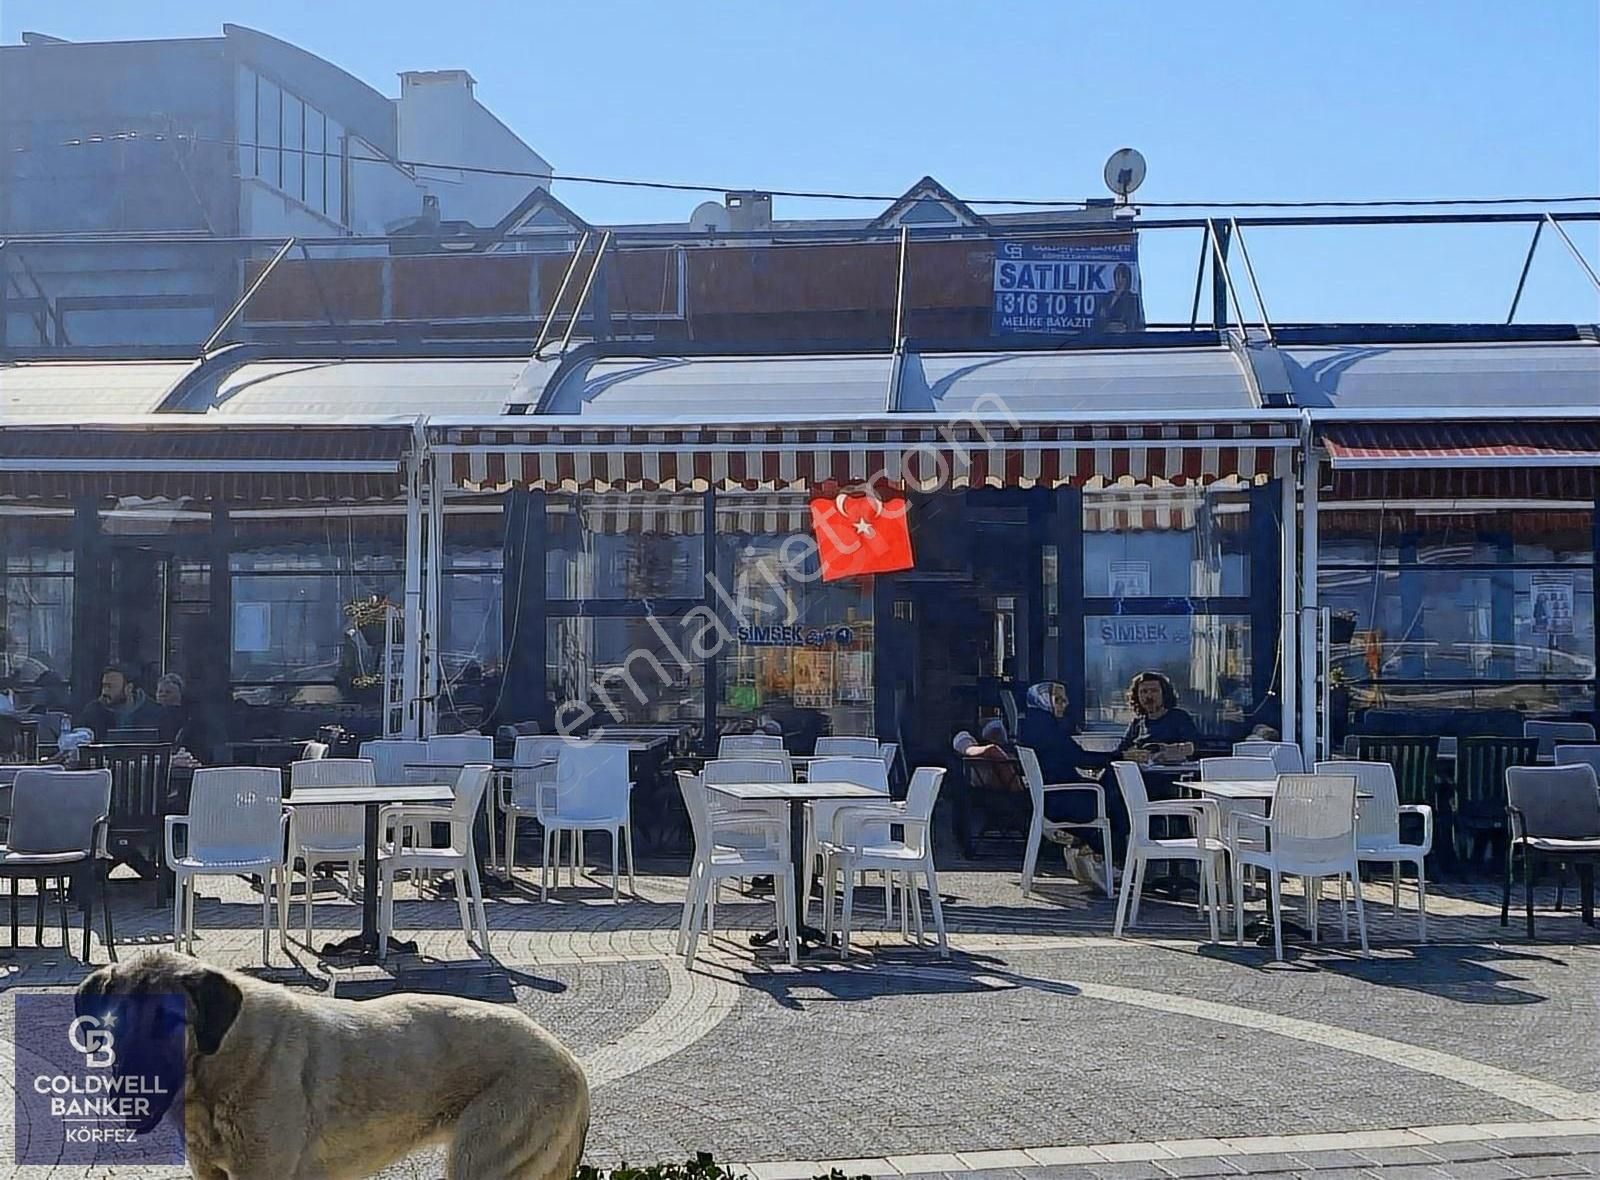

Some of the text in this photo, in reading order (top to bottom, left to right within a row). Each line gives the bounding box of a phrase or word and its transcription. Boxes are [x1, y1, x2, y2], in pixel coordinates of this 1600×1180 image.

[1000, 263, 1107, 290] SATILIK
[1046, 294, 1067, 315] 10
[1074, 295, 1095, 315] 10
